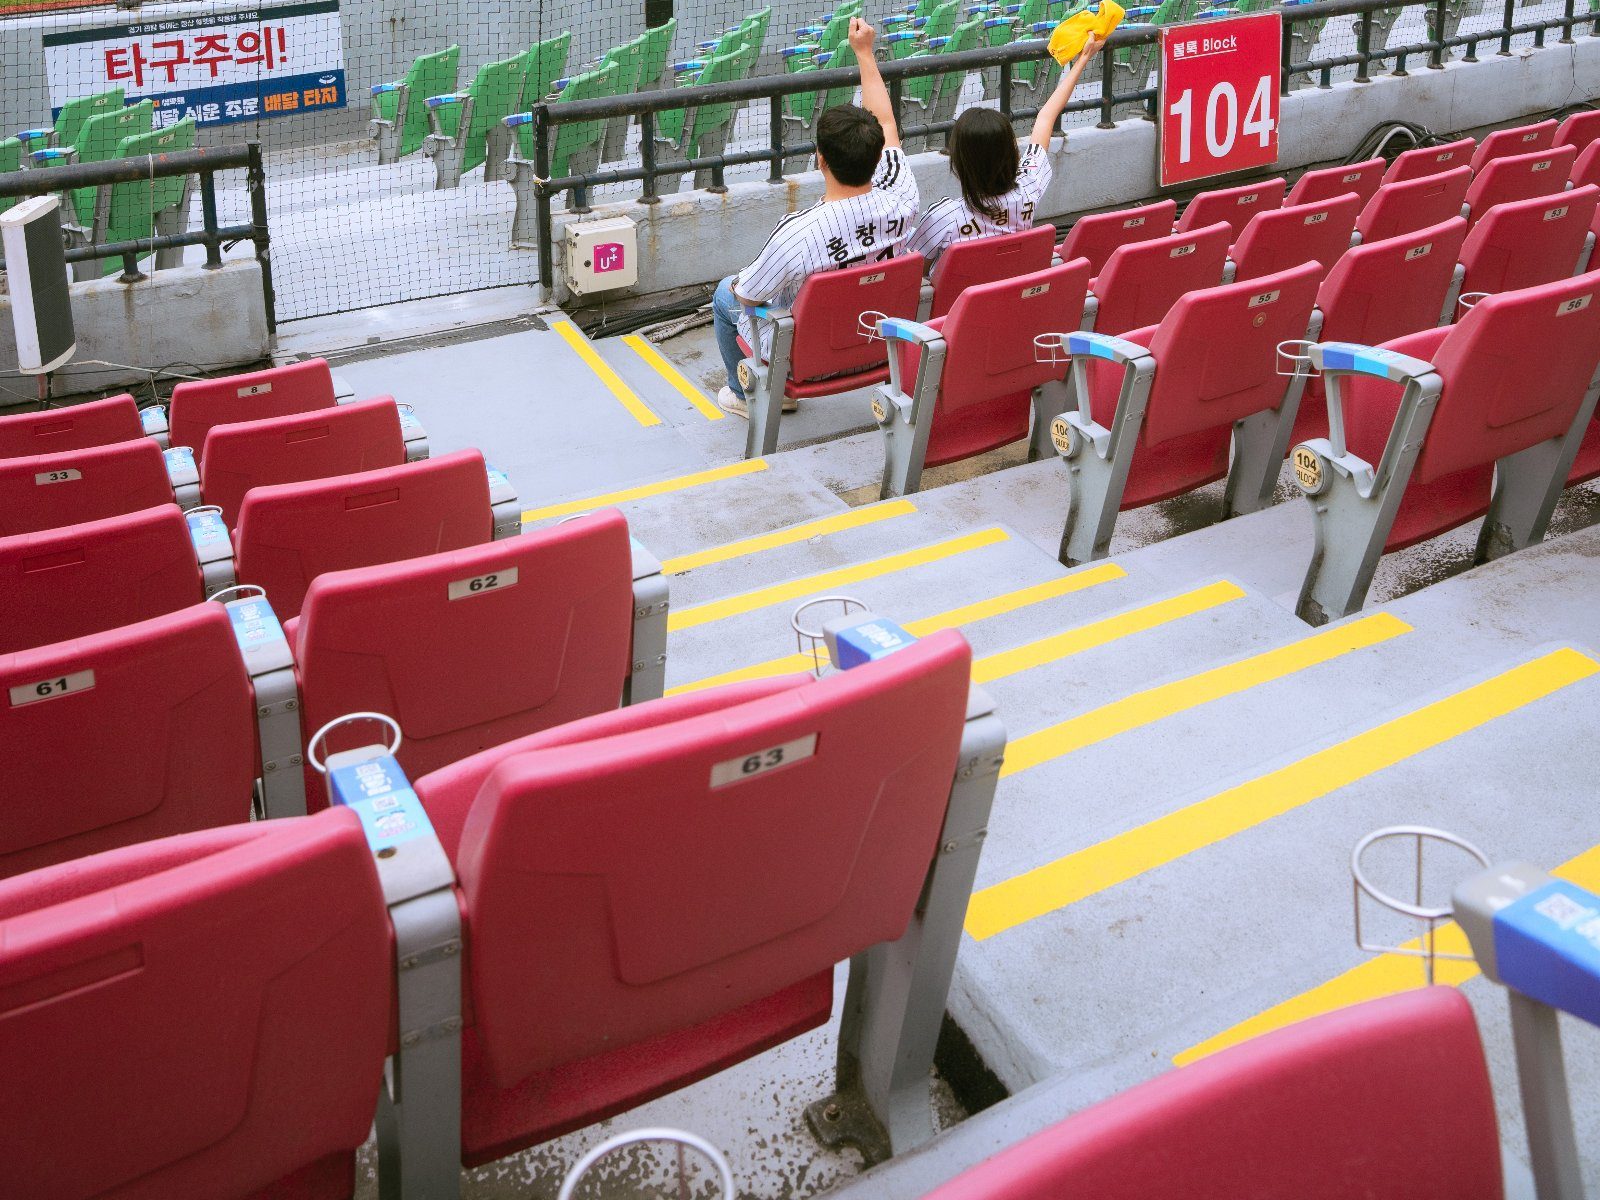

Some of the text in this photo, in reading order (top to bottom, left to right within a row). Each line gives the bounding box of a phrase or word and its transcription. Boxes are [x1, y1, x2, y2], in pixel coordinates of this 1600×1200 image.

[1174, 35, 1237, 58] 블록 Block
[104, 26, 287, 87] 타구주의!
[225, 98, 259, 117] 주문
[264, 92, 298, 112] 배달
[303, 86, 338, 107] 타자
[1170, 75, 1275, 164] 104
[960, 201, 1034, 236] 이병규
[1311, 214, 1322, 222] 30
[1551, 209, 1562, 218] 53
[1178, 246, 1189, 255] 29
[1413, 247, 1424, 256] 54
[600, 253, 618, 270] U+
[867, 274, 878, 283] 27
[1030, 286, 1042, 295] 28
[1257, 294, 1271, 303] 55
[1567, 298, 1583, 311] 56
[250, 386, 258, 394] 8
[1297, 452, 1317, 471] 104
[50, 471, 69, 481] 33
[469, 575, 498, 592] 62
[36, 677, 69, 696] 61
[742, 747, 784, 774] 63
